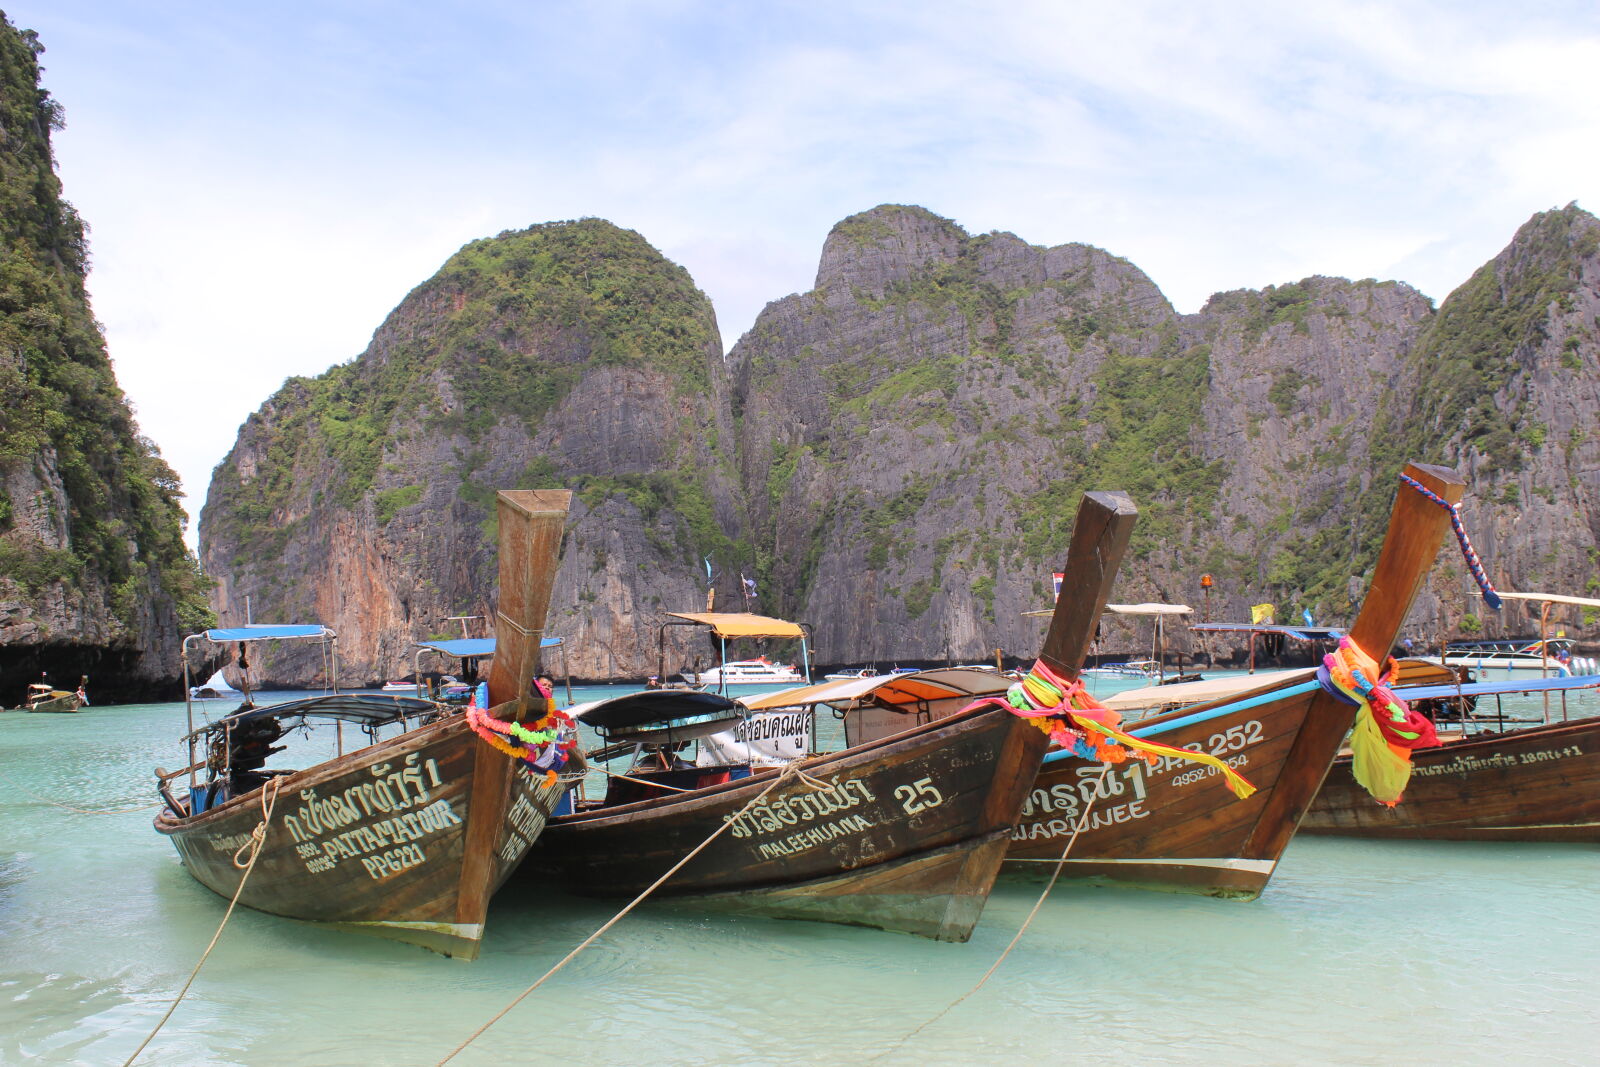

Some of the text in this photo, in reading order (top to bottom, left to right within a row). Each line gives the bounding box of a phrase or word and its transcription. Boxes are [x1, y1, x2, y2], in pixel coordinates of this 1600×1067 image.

[1208, 720, 1264, 756] 252
[1172, 754, 1249, 787] 4952 054
[894, 777, 943, 815] 25
[758, 814, 874, 860] MALEEHUANA
[361, 843, 426, 880] PPG221
